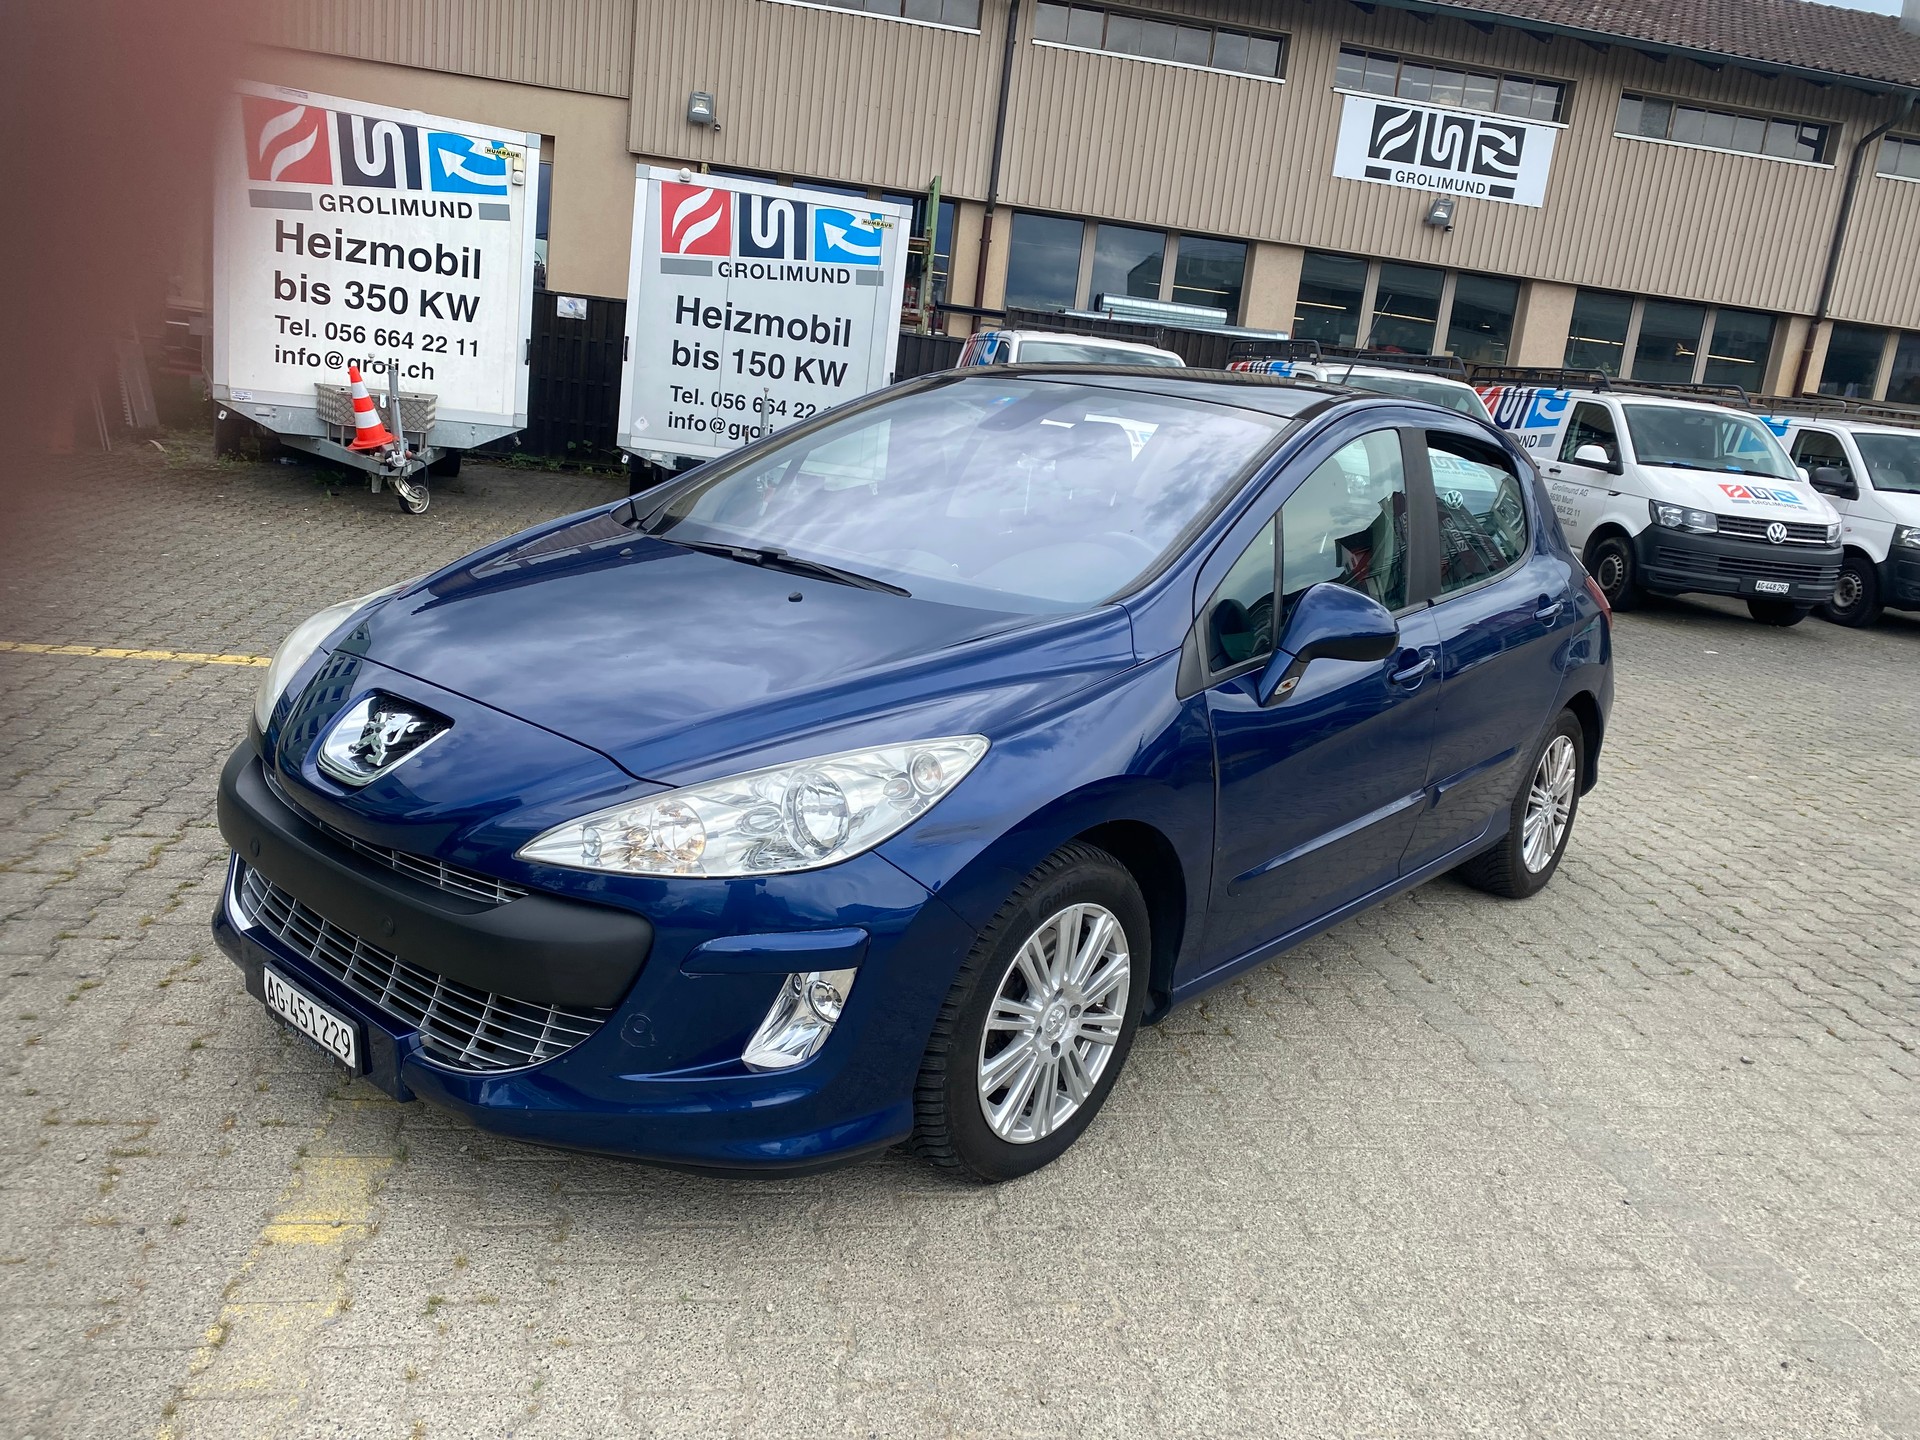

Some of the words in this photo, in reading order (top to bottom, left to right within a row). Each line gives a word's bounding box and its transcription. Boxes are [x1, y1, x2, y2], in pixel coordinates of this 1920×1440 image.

[1395, 171, 1486, 195] GROLIMUND
[319, 193, 473, 219] GROLIMUND
[275, 219, 481, 280] Heizmobil
[718, 262, 850, 284] GROLIMUND
[274, 270, 332, 305] bis
[344, 281, 409, 315] 350
[420, 290, 480, 323] KW
[274, 315, 317, 339] Tel.
[324, 322, 367, 344] 056
[374, 328, 415, 350] 664
[422, 334, 448, 354] 22
[456, 339, 479, 357] 11
[675, 295, 851, 347] Heizmobil
[672, 340, 720, 370] bis
[732, 349, 785, 380] 150
[794, 356, 848, 387] KW
[670, 385, 704, 405] Tel.
[711, 391, 746, 411] 056
[793, 402, 816, 419] 22
[1579, 488, 1589, 497] AG
